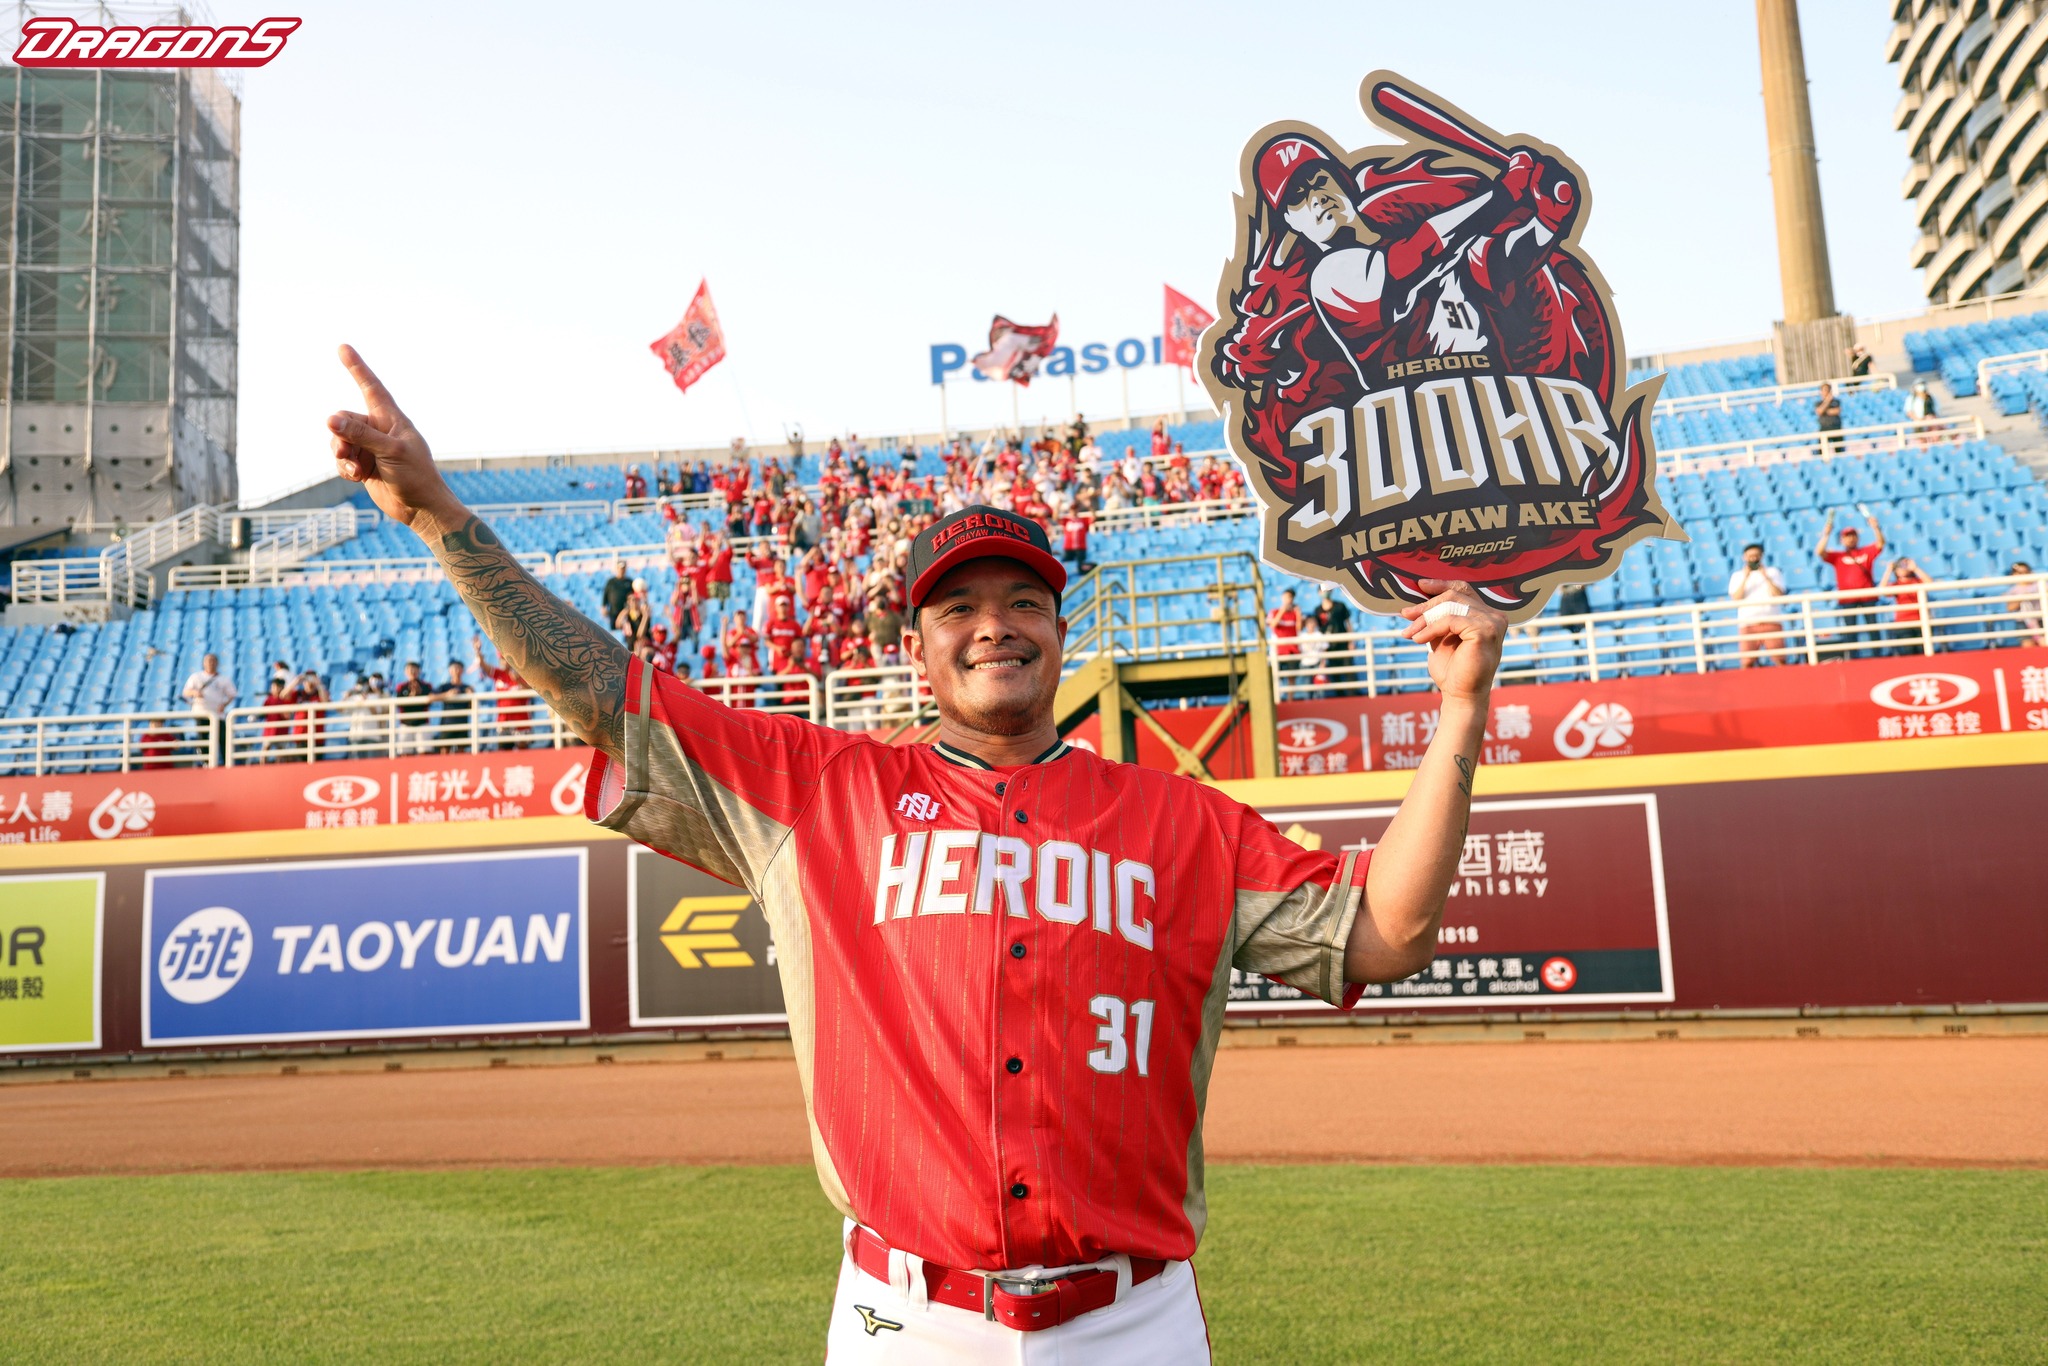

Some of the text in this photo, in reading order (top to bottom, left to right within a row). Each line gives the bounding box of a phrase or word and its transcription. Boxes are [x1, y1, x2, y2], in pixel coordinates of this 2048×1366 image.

[1276, 141, 1303, 168] W
[1441, 299, 1474, 331] 31
[1387, 353, 1491, 381] HEROIC
[1286, 374, 1620, 543] 300HR
[930, 513, 1031, 554] HEROIC
[954, 529, 989, 546] NGAYAW
[1340, 497, 1601, 561] NGAYAW AKE'
[1908, 679, 1941, 706] 光
[1877, 711, 1982, 739] 新光金控
[1278, 752, 1348, 776] 光金控
[1485, 744, 1522, 765] Life
[407, 764, 534, 803] 新光人壽
[408, 805, 445, 823] Shin
[493, 800, 524, 819] Life
[873, 829, 1157, 952] HEROIC
[0, 925, 46, 967] R
[272, 912, 571, 975] TAOYUAN
[1391, 980, 1453, 996] influence
[1462, 979, 1478, 995] of
[1488, 978, 1540, 994] alcohol
[1087, 993, 1156, 1077] 31
